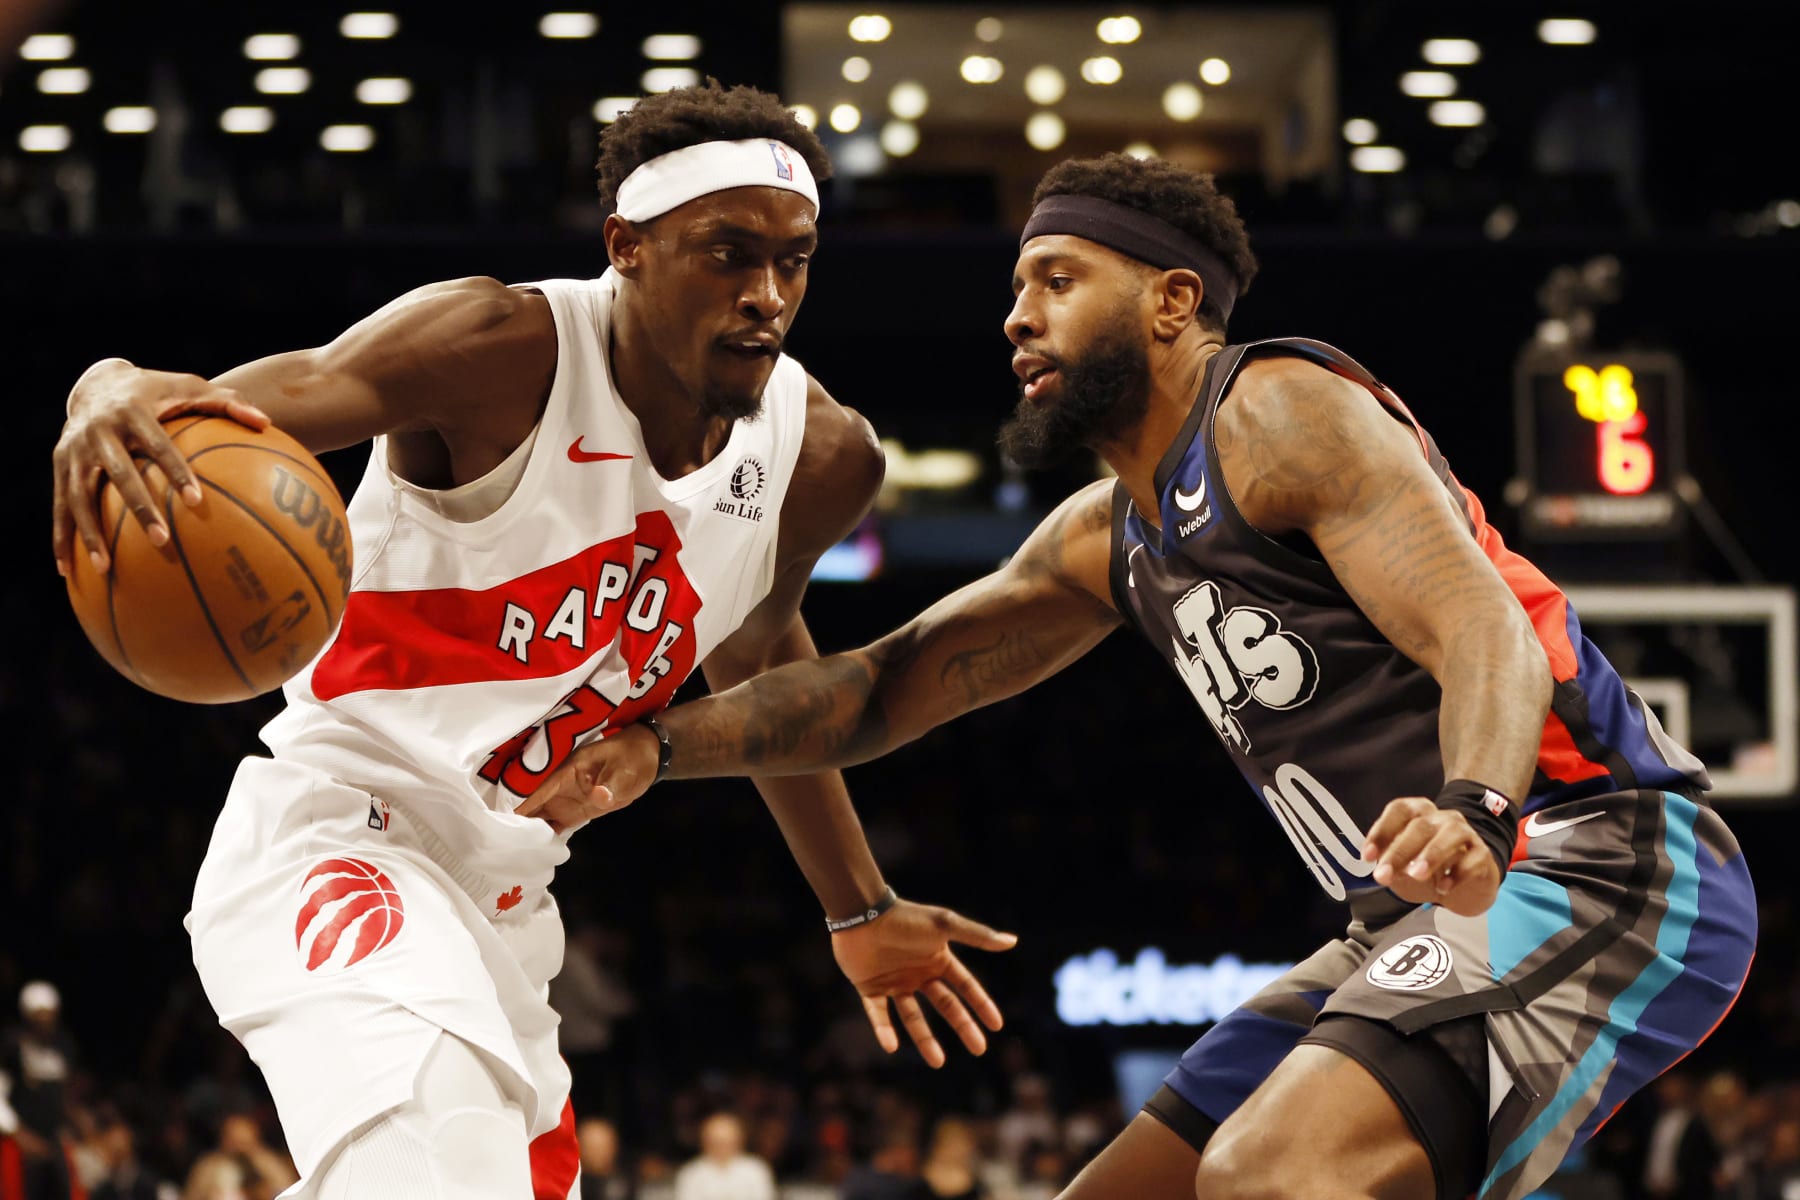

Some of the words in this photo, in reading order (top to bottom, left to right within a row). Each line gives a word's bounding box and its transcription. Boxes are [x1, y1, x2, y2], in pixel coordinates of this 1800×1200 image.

[1597, 409, 1654, 495] 6
[737, 503, 763, 522] Life
[1178, 504, 1211, 538] Webull
[498, 543, 683, 701] RAPTORS
[1263, 762, 1378, 901] 00
[1386, 944, 1430, 976] B
